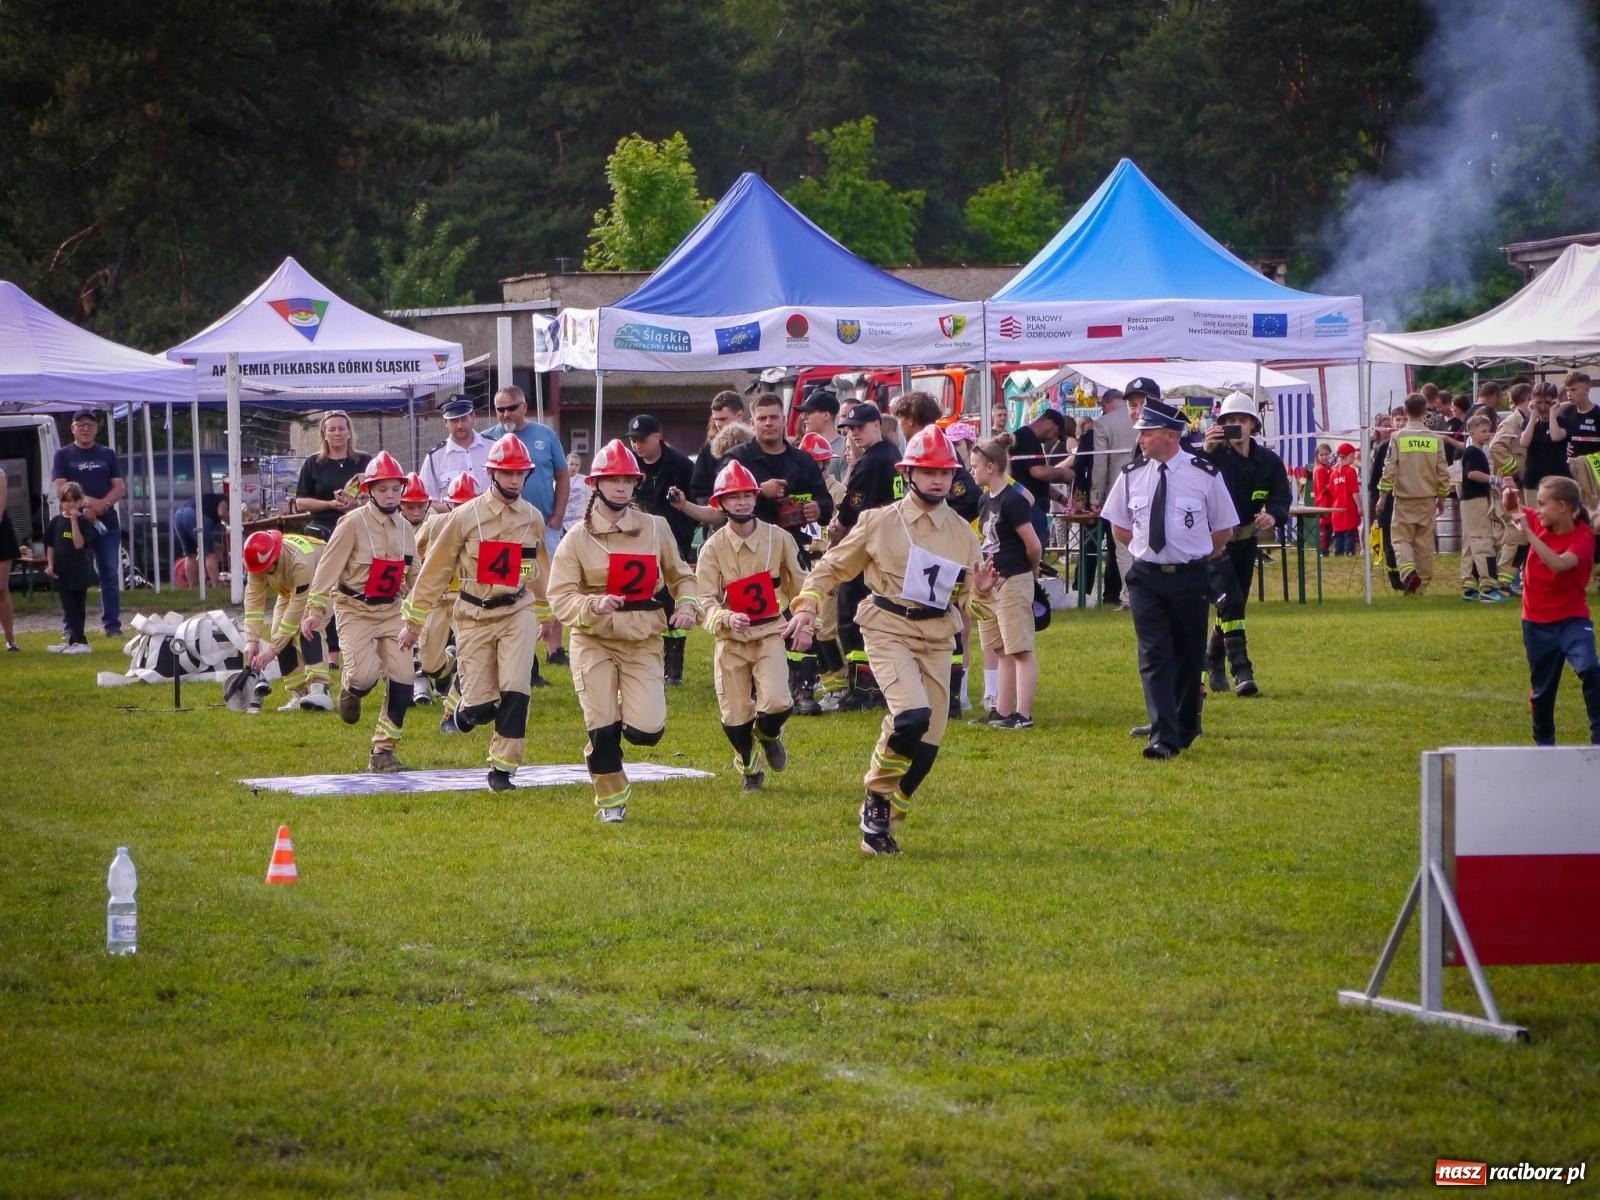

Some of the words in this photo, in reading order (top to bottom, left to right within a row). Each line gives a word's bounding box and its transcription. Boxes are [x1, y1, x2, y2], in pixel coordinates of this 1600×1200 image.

[1026, 323, 1046, 331] PLAN
[1127, 315, 1175, 324] Rzeczpospolita
[643, 328, 689, 344] Śląskie
[1026, 331, 1072, 339] ODBUDOWY
[1188, 327, 1248, 337] NextGenerationEU
[273, 361, 336, 376] PIŁKARSKA
[338, 359, 373, 374] GÓRKI
[376, 359, 421, 375] ŚLĄSKIE
[489, 547, 511, 579] 4
[377, 566, 399, 593] 5
[621, 560, 647, 595] 2
[923, 564, 941, 602] 1
[743, 583, 767, 615] 3
